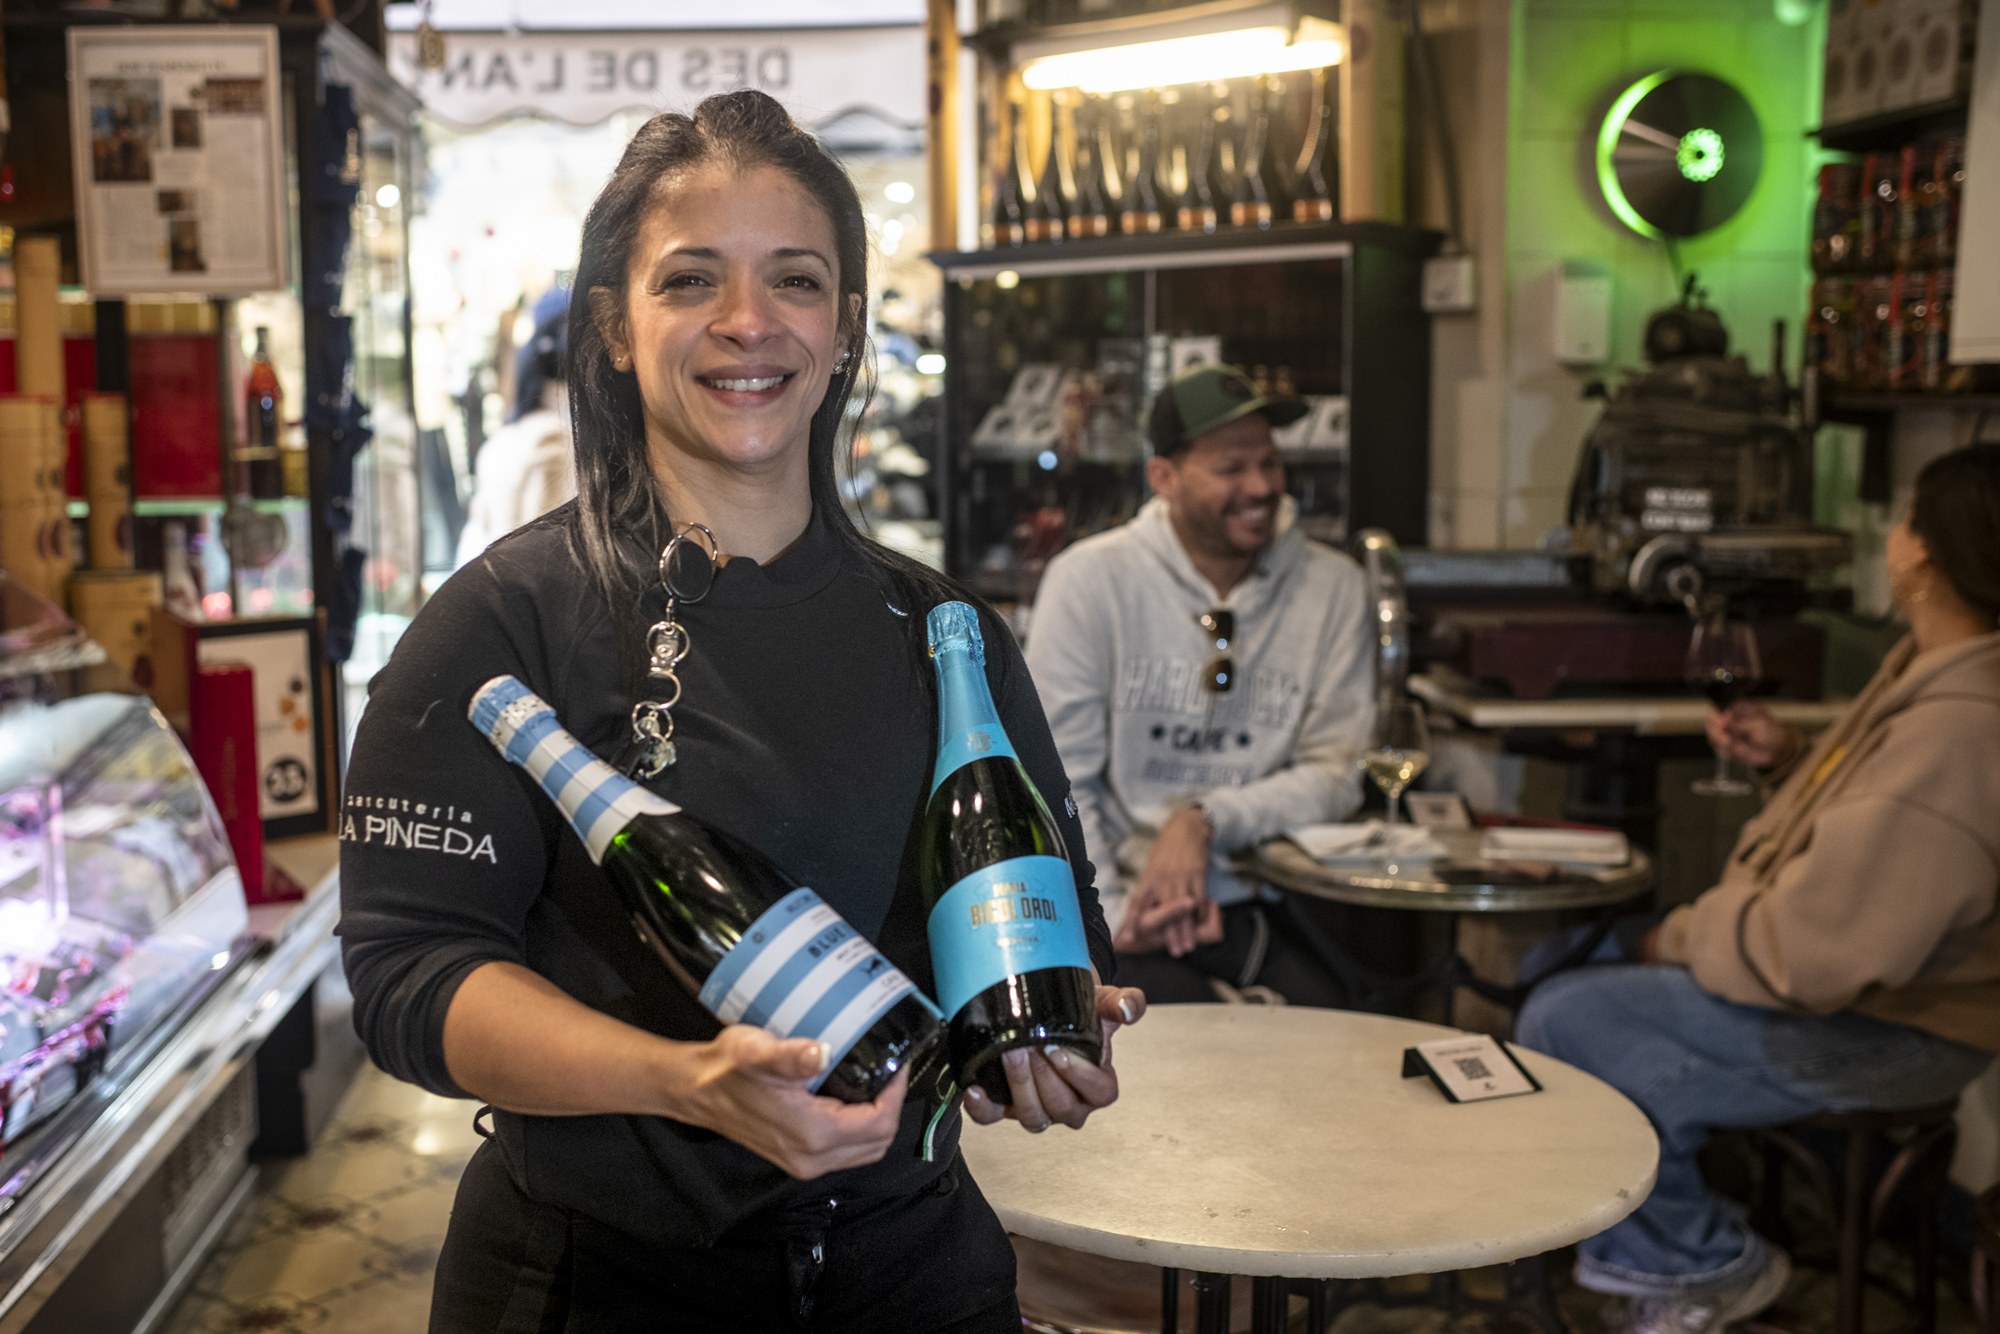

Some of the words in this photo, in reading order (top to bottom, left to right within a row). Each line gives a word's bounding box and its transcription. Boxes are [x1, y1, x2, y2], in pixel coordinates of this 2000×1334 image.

[338, 813, 358, 842] LA
[364, 814, 498, 865] PINEDA
[1020, 896, 1057, 922] ORDI
